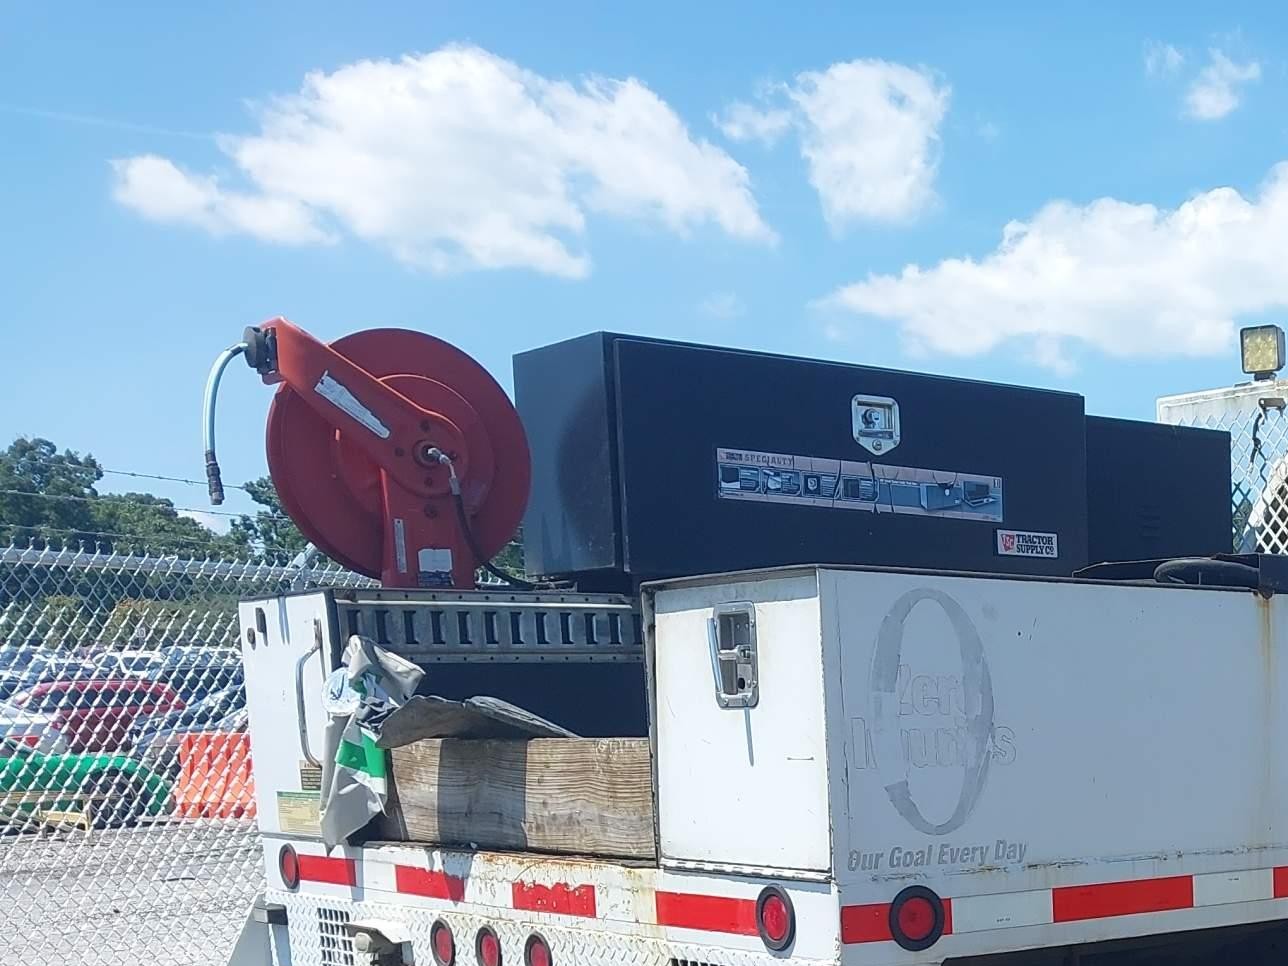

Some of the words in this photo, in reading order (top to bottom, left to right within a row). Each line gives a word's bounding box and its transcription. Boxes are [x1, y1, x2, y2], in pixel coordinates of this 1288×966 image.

[1016, 534, 1054, 546] TRACTOR
[1016, 544, 1045, 555] SUPPLY
[847, 849, 885, 872] Our
[888, 844, 934, 869] Goal
[937, 843, 990, 867] Every
[994, 839, 1027, 864] Day
